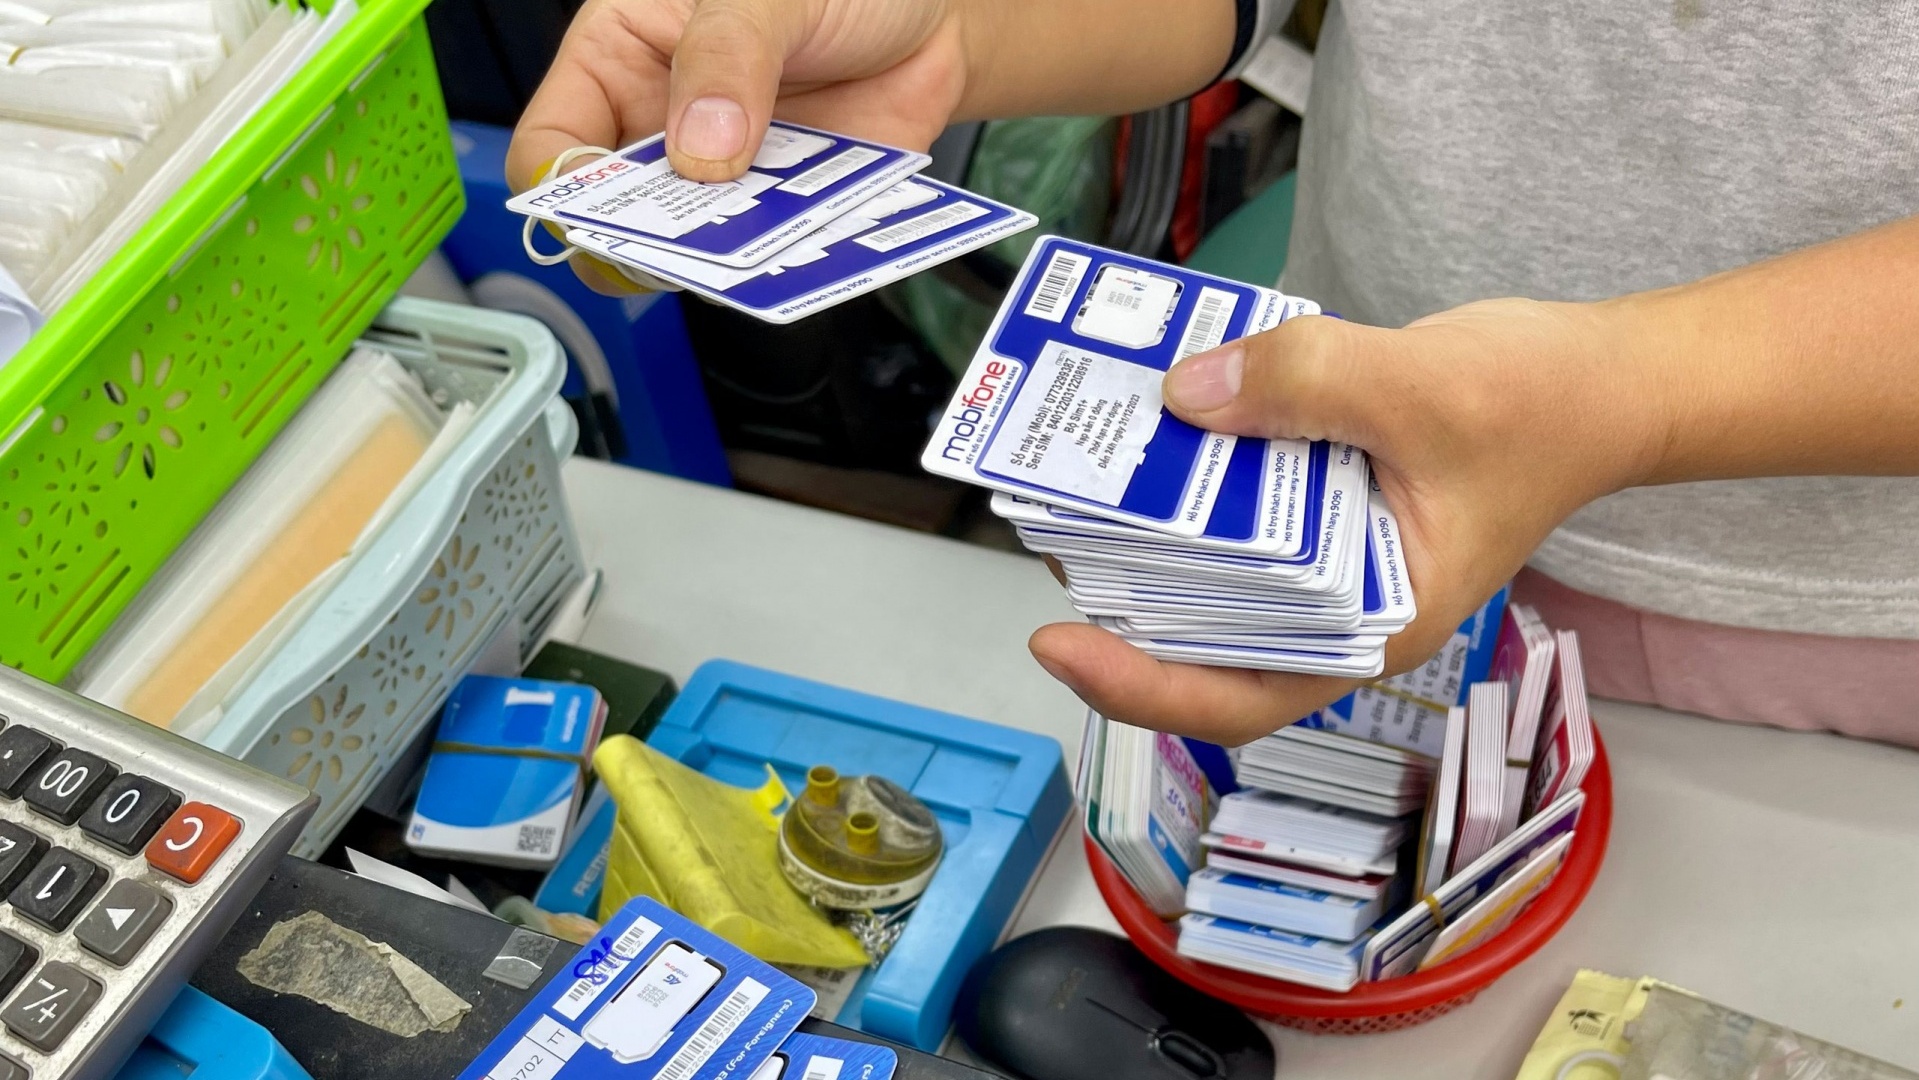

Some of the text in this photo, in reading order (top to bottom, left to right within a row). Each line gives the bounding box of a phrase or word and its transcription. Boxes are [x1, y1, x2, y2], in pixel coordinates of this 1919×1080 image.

[529, 160, 630, 207] mobifone
[942, 361, 1006, 462] mobifone
[1010, 357, 1077, 465] Số máy (Mobi): 0773299387
[1026, 356, 1093, 470] Seri SIM: 8401220312208916
[1064, 421, 1079, 434] Bộ
[1185, 437, 1225, 522] Hỗ trợ khách hàng 9090
[1265, 451, 1286, 538] Hỗ trợ khách hàng 9090
[1313, 488, 1343, 576] Hỗ trợ khách hàng 9090
[1378, 516, 1403, 606] Hỗ trợ khách hàng 9090
[546, 1028, 566, 1045] TT
[727, 1050, 747, 1073] (For
[744, 998, 794, 1051] Foreigners)
